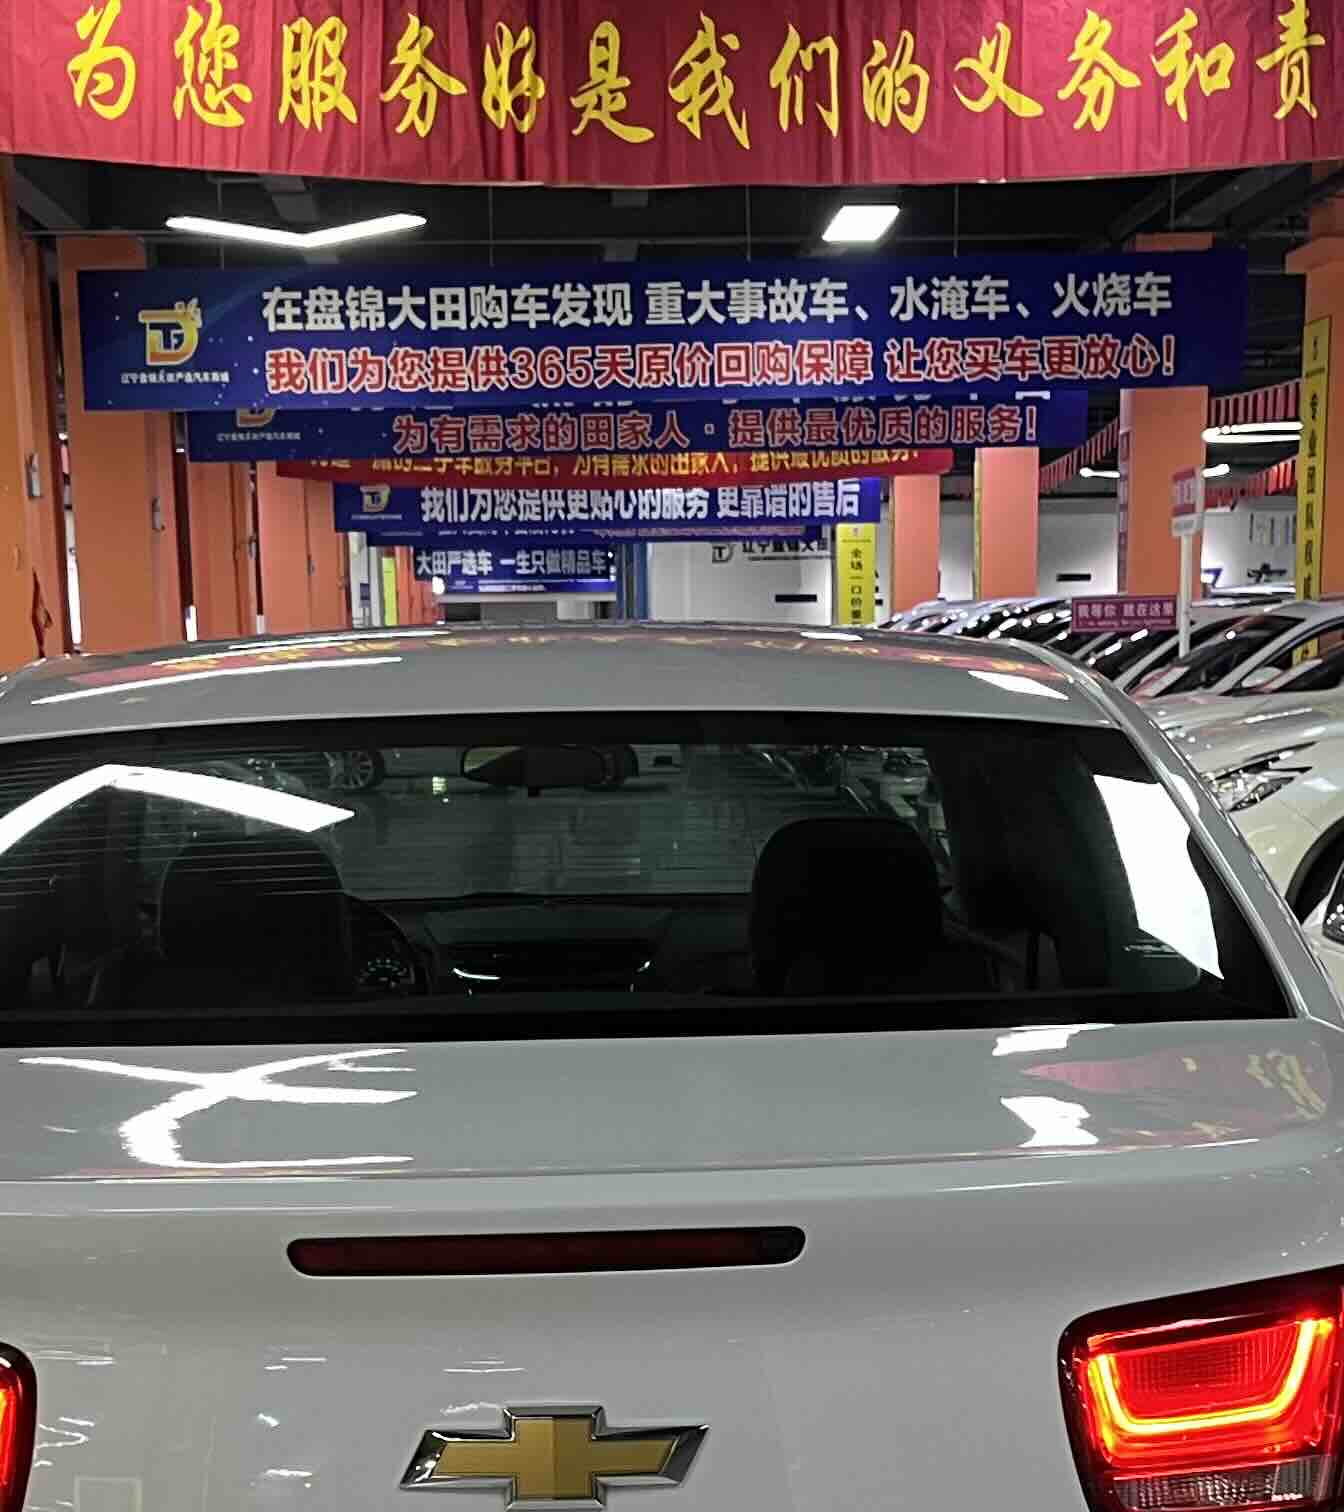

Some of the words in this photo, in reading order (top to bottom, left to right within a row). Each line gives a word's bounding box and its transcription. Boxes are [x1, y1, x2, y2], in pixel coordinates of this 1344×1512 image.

[260, 281, 632, 333] 在盘锦大田购车发现
[645, 272, 1173, 327] 重大事故车、水淹车、火烧车
[266, 339, 874, 395] 我们为您提供365天原价回购保障
[885, 335, 1175, 385] 让您买车更放心!
